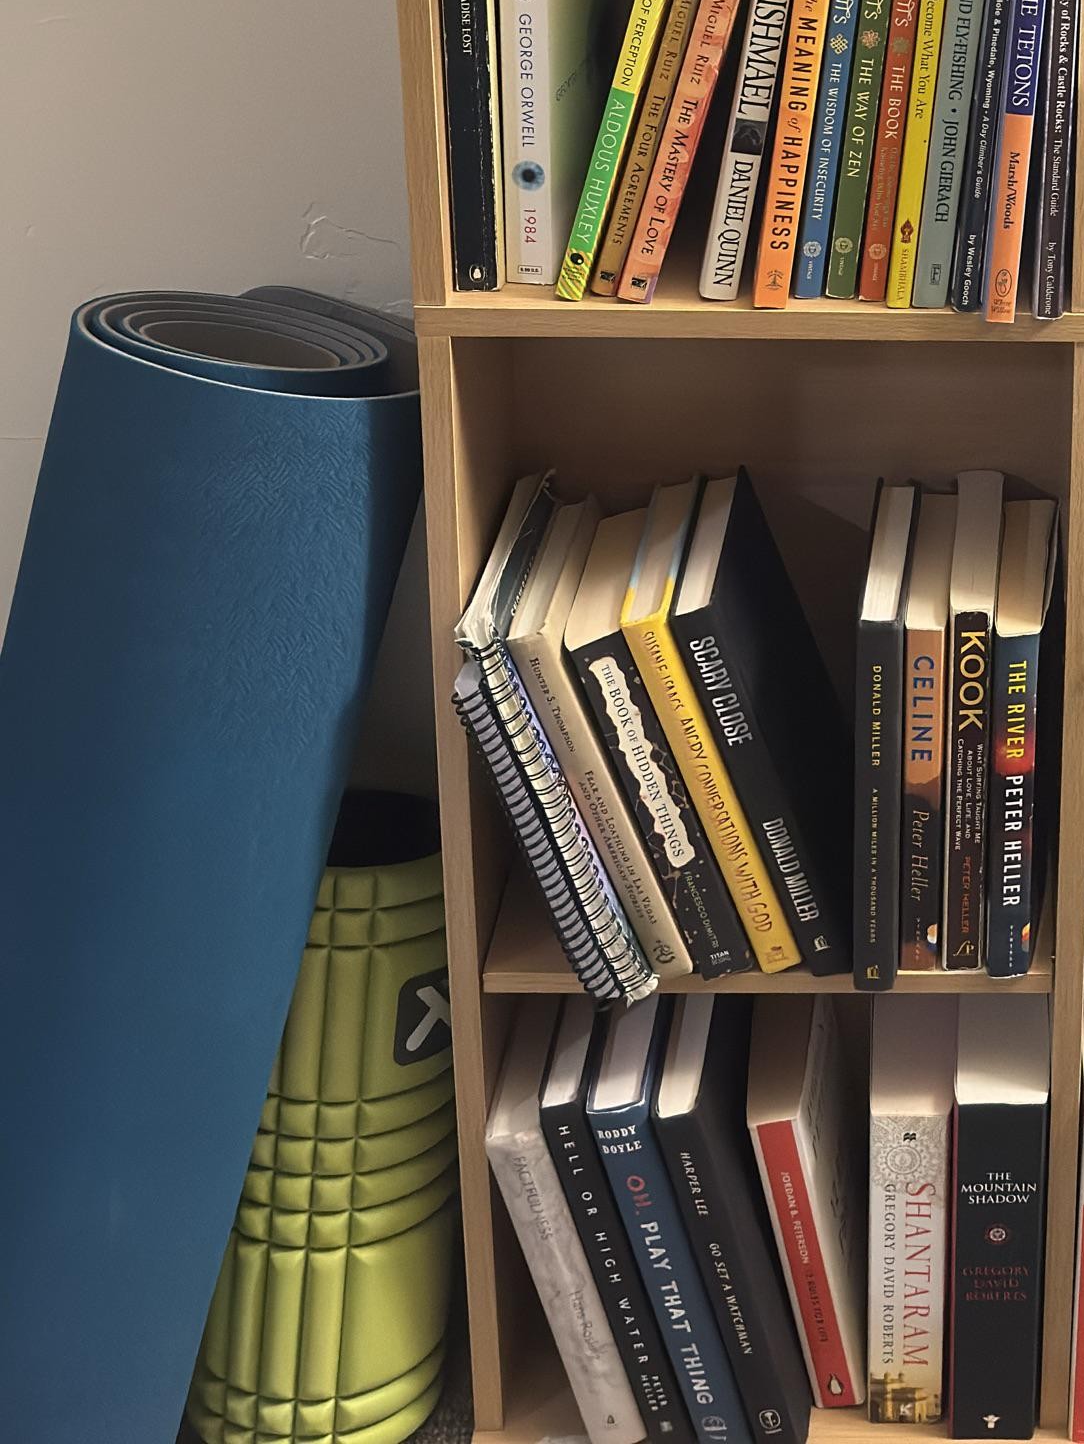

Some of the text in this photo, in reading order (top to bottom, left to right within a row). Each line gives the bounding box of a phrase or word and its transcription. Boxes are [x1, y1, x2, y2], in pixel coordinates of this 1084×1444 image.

[621, 17, 647, 86] PERCEPTION
[1059, 22, 1070, 52] Rocks
[1060, 9, 1071, 21] of
[518, 13, 535, 147] GEORGE ORWELL
[788, 17, 817, 110] MEANING
[1012, 24, 1036, 106] TETONS
[1056, 67, 1068, 98] Castle
[1058, 54, 1069, 64] &
[787, 117, 801, 133] of
[1054, 100, 1066, 133] Rocks:
[576, 99, 625, 244] ALDOUS HUXLEY
[770, 136, 802, 250] HAPPINESS
[1003, 152, 1020, 229] Marsh/Woods
[524, 209, 537, 243] 1984
[713, 160, 754, 286] DANIEL QUINN
[689, 636, 752, 746] SCARY CLOSE
[871, 665, 882, 766] DONALD MILLER
[911, 656, 934, 761] CELINE
[958, 631, 985, 730] KOOK
[1005, 660, 1027, 758] THE RIVER
[762, 818, 819, 921] DONALD MILLER
[1003, 775, 1023, 905] PETER HELLER
[598, 1125, 637, 1140] RODDY
[602, 1140, 642, 1155] DOYLE
[961, 1182, 1037, 1193] MOUNTAIN
[968, 1194, 1030, 1204] SHADOW
[987, 1172, 1012, 1181] THE
[640, 1221, 672, 1269] PLAY
[661, 1280, 691, 1332] THAT
[681, 1343, 713, 1404] THING
[882, 1183, 897, 1364] GREGORY DAVID ROBERTS
[903, 1181, 936, 1365] SHANTARAM
